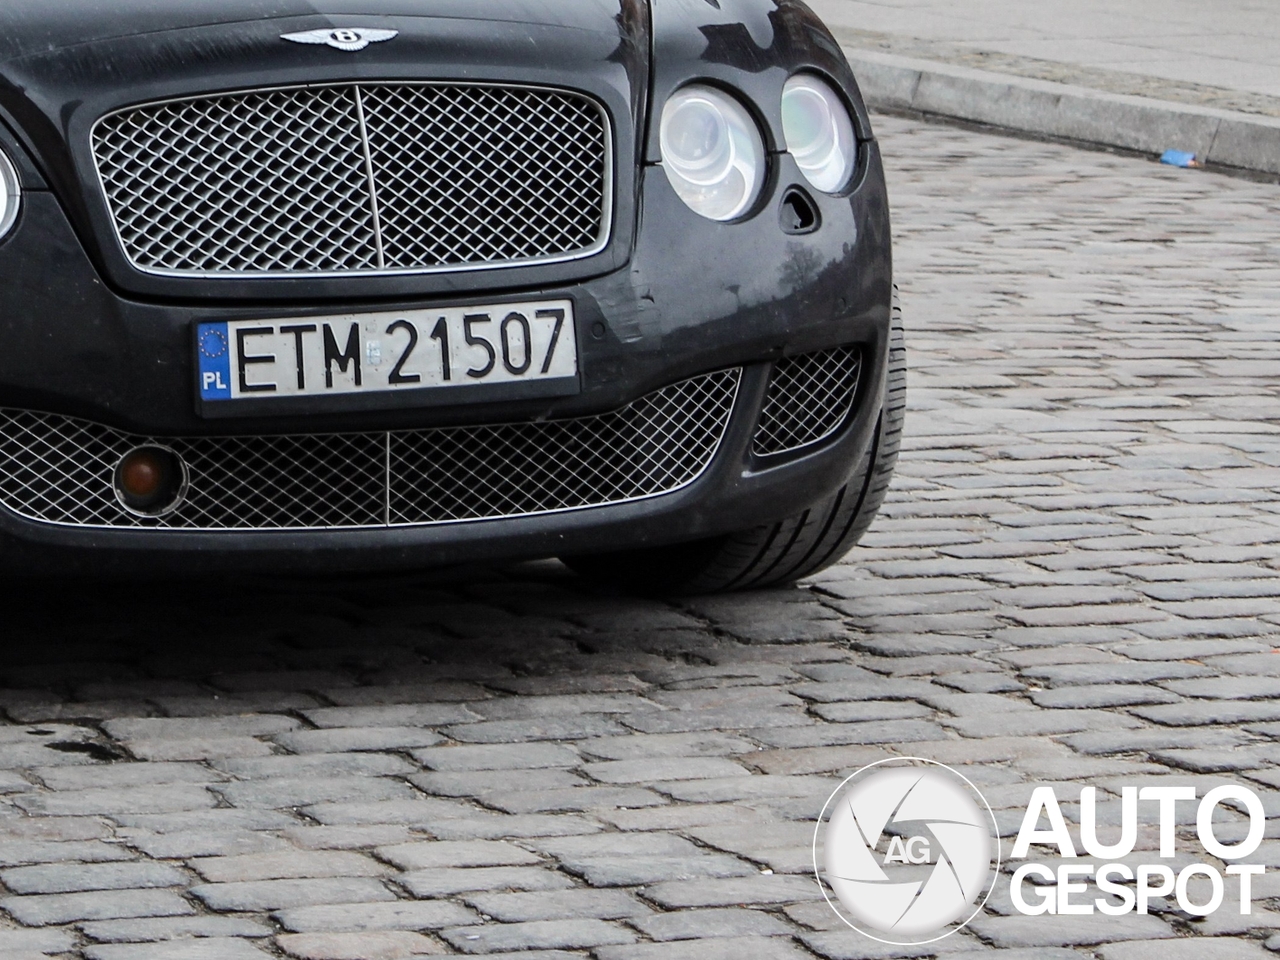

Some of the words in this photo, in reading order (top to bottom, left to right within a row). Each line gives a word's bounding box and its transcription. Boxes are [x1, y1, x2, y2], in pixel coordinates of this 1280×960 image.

[236, 323, 362, 393] ETM
[385, 308, 565, 385] 21507
[203, 372, 227, 390] PL
